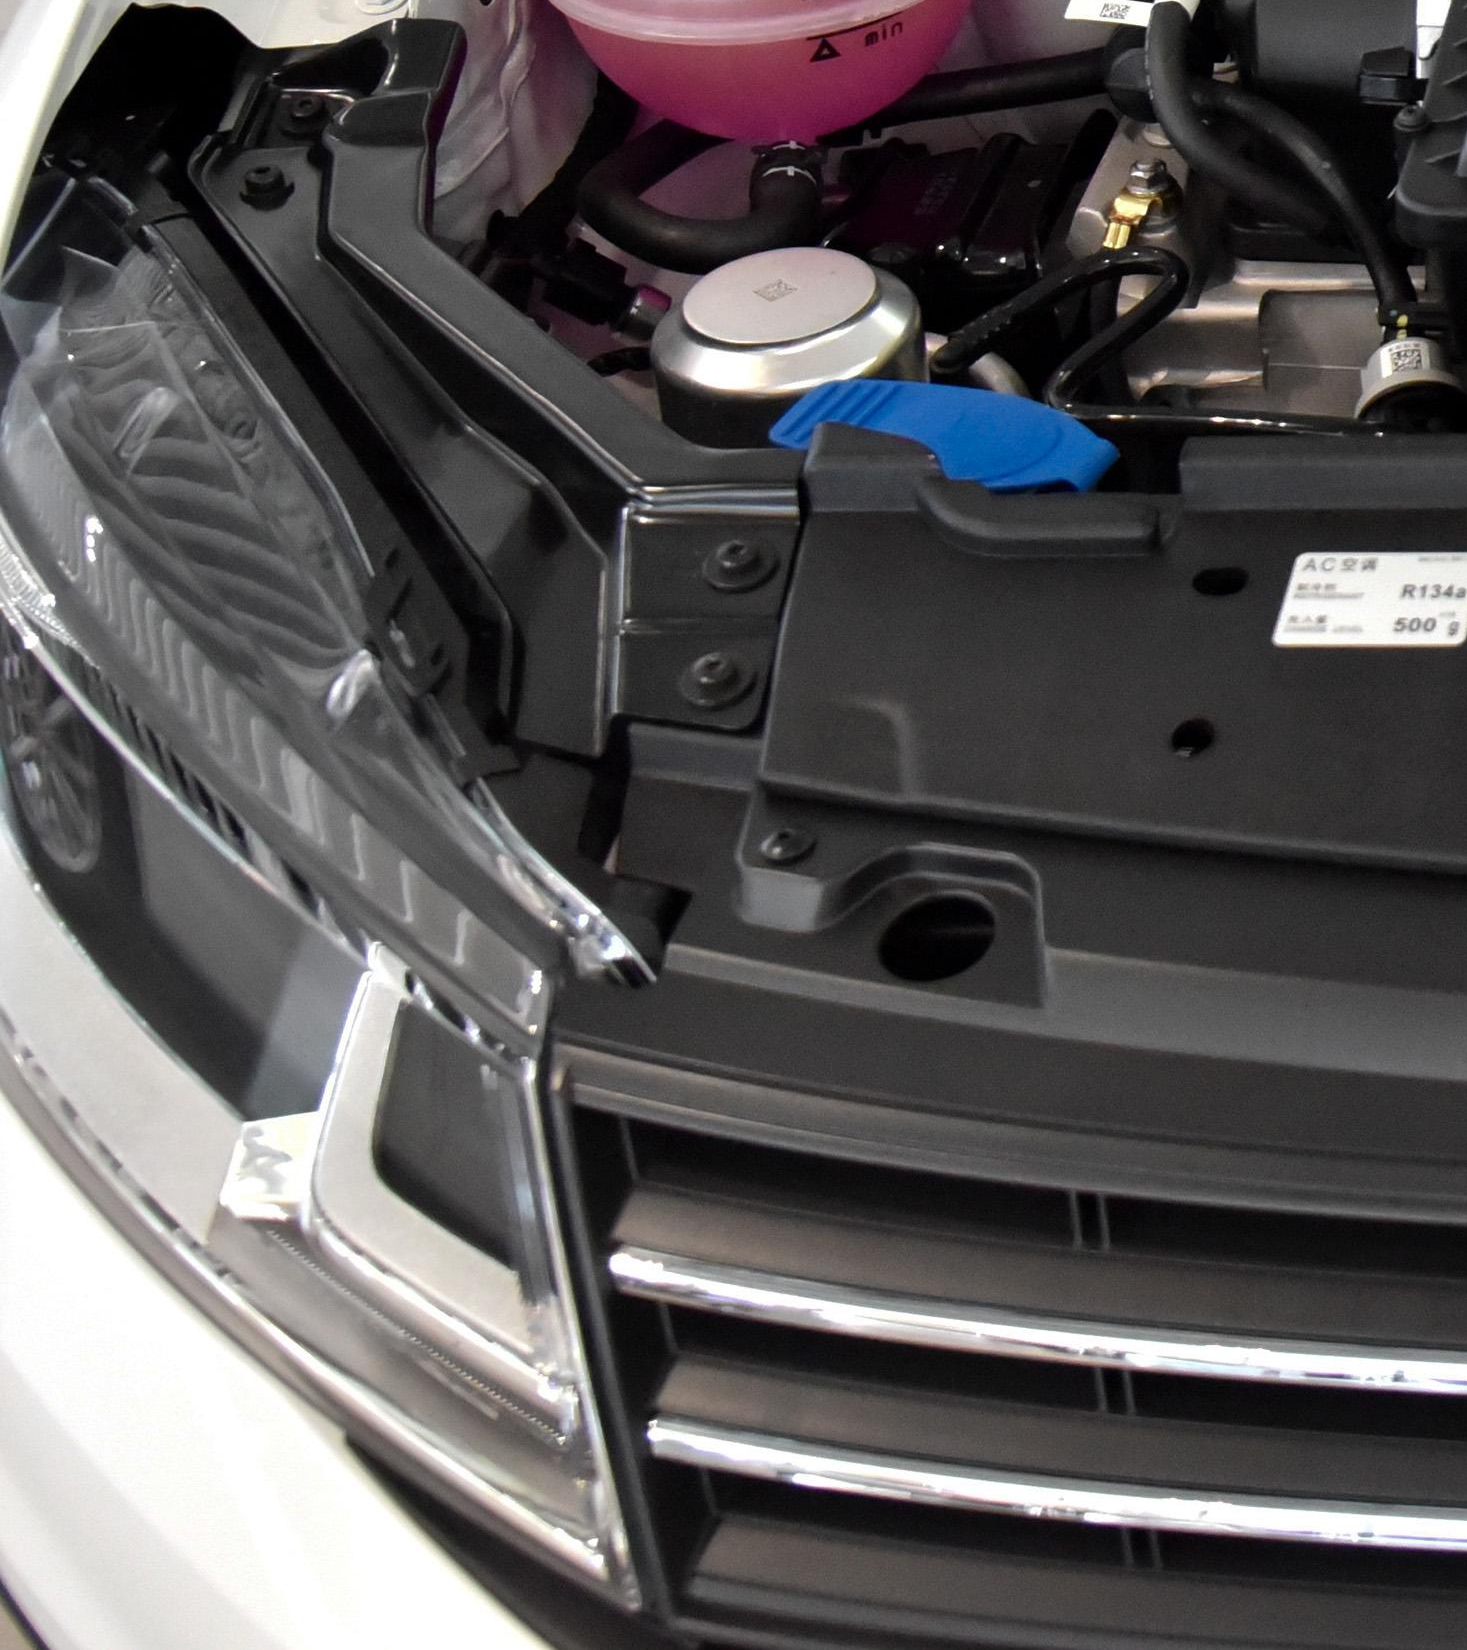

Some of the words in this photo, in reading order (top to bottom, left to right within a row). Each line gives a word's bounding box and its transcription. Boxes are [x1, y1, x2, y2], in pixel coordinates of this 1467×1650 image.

[864, 21, 903, 47] min
[1402, 583, 1467, 599] R134a
[1393, 617, 1437, 632] 500
[1447, 621, 1460, 637] g
